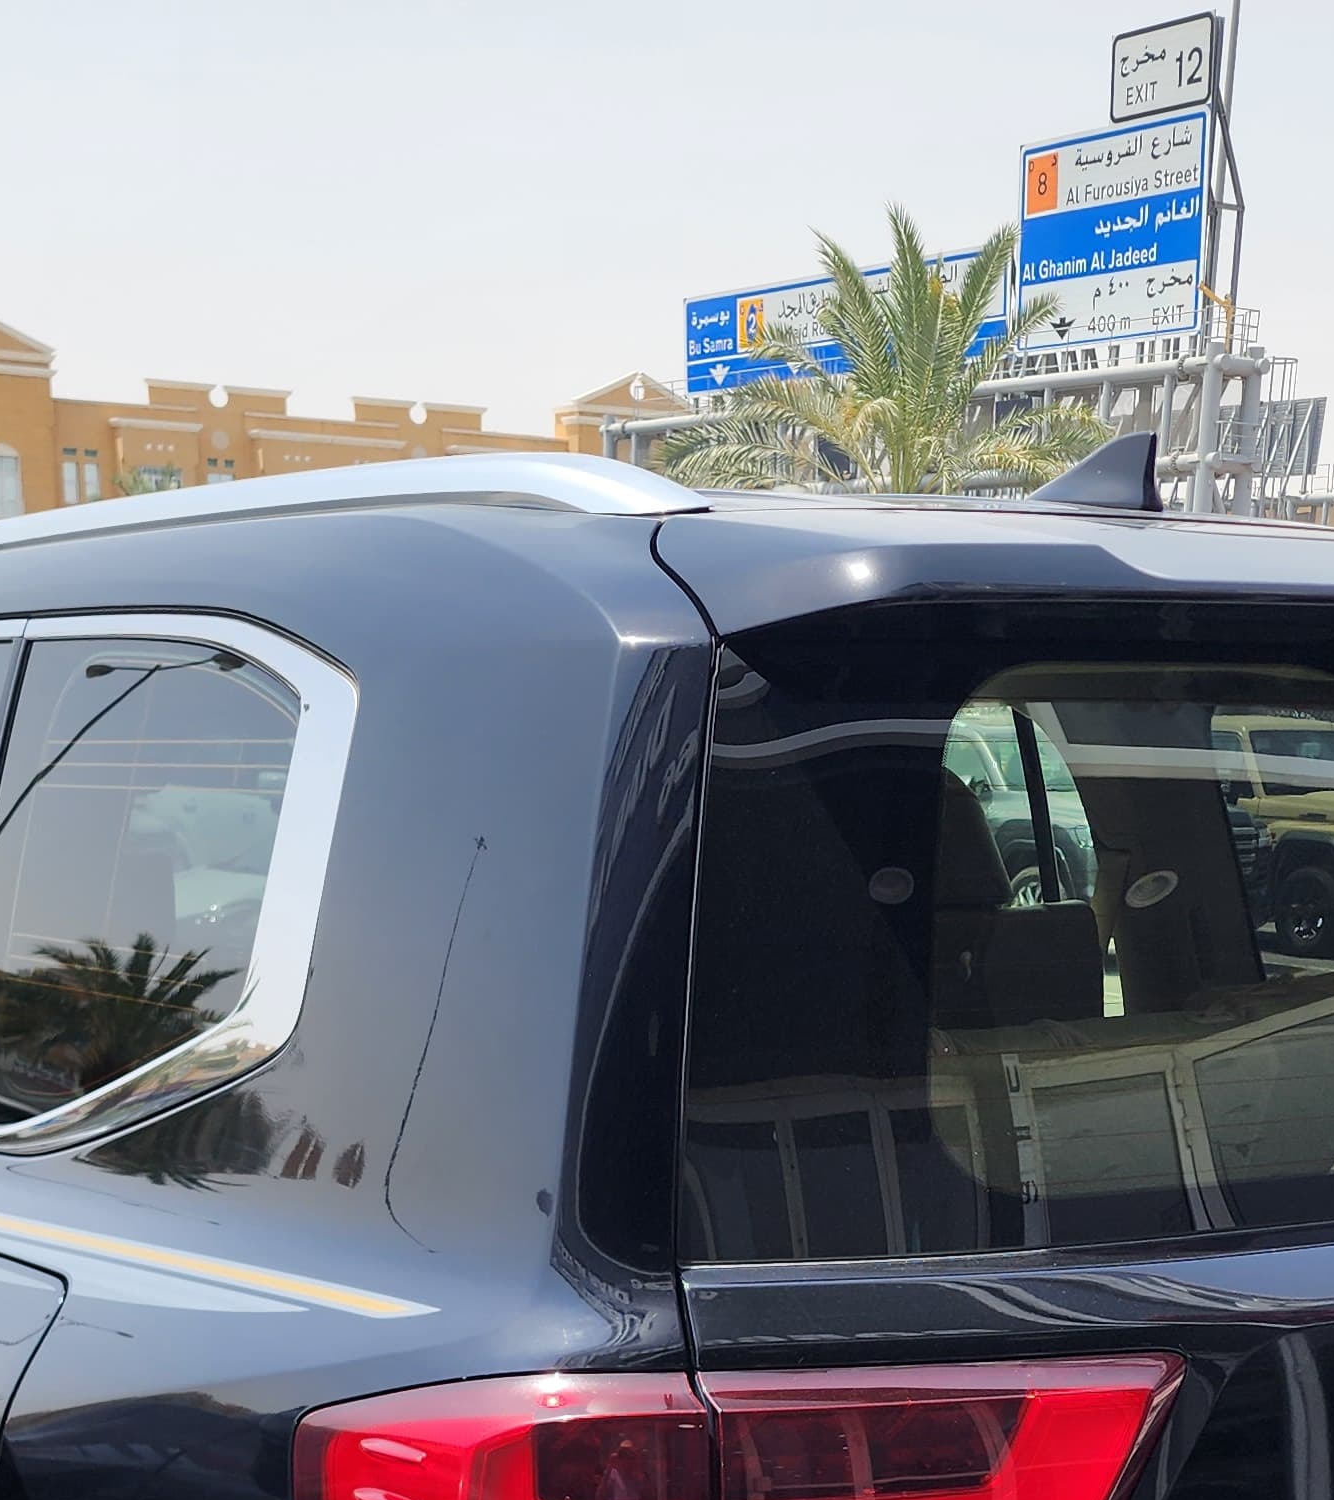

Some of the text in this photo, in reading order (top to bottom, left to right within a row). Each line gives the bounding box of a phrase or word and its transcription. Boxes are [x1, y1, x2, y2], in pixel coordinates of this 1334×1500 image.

[1120, 44, 1166, 77] مخرج
[1176, 46, 1203, 88] 12
[1126, 81, 1158, 106] EXIT
[1075, 125, 1193, 171] شارع الفروسية
[1037, 172, 1048, 196] 8
[1065, 163, 1199, 207] Al Furousiya Street
[1094, 193, 1200, 239] الغانم الجديد
[1022, 243, 1157, 282] Al Ghanim Al Jadeed
[1145, 268, 1194, 297] مخرج
[691, 309, 731, 330] بوسمرة
[1087, 304, 1185, 334] 400 m EXIT
[689, 337, 734, 356] Bu Samra
